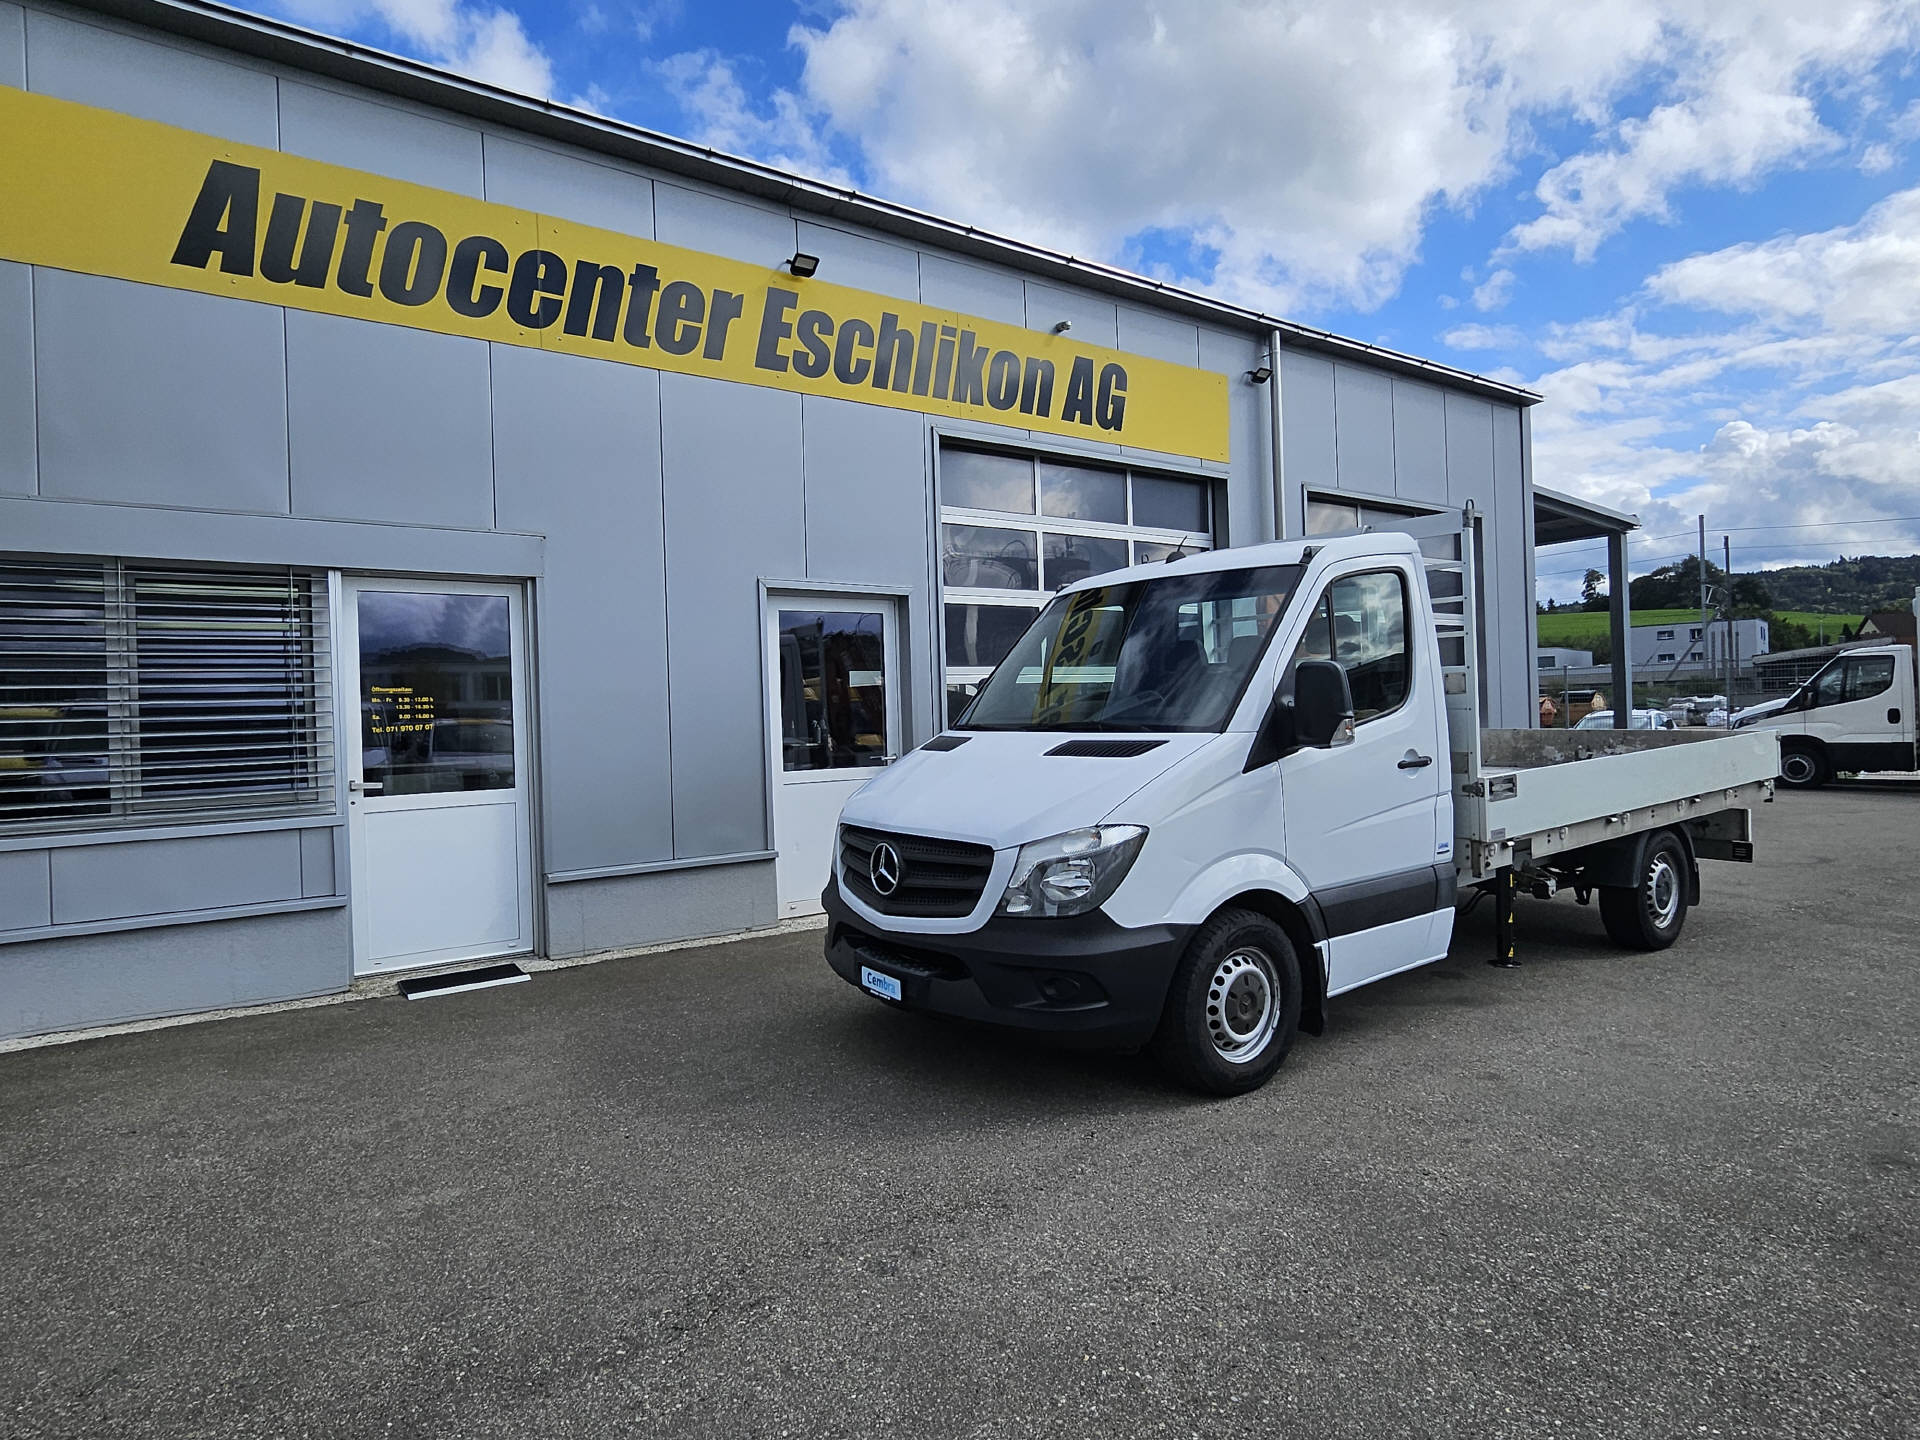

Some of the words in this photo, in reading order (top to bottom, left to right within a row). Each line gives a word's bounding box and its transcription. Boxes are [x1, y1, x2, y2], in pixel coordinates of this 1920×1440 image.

[170, 159, 746, 361] Autocenter
[754, 286, 1055, 419] Eschlikon
[1061, 356, 1128, 432] AG
[867, 972, 896, 994] Cembra
